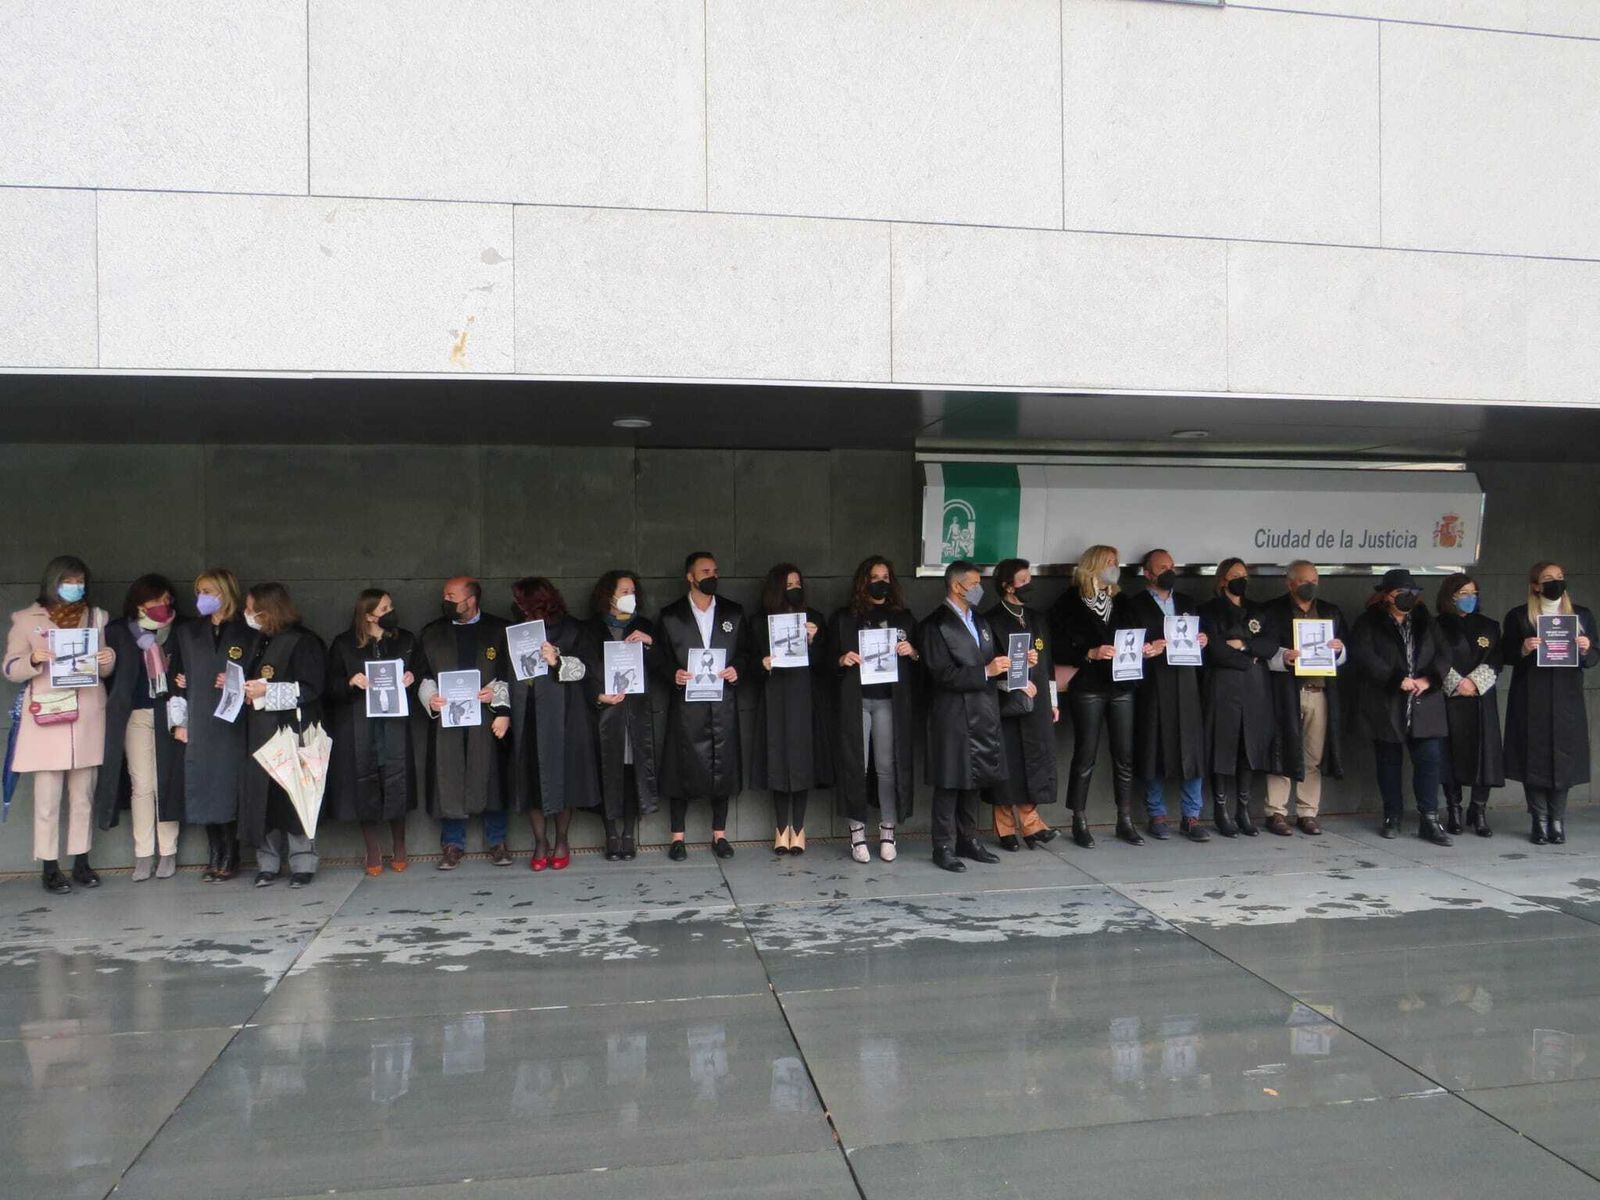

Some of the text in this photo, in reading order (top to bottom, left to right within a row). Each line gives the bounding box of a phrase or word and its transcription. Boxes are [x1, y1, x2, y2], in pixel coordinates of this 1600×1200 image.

[1254, 528, 1418, 549] Ciudad de la Justicia
